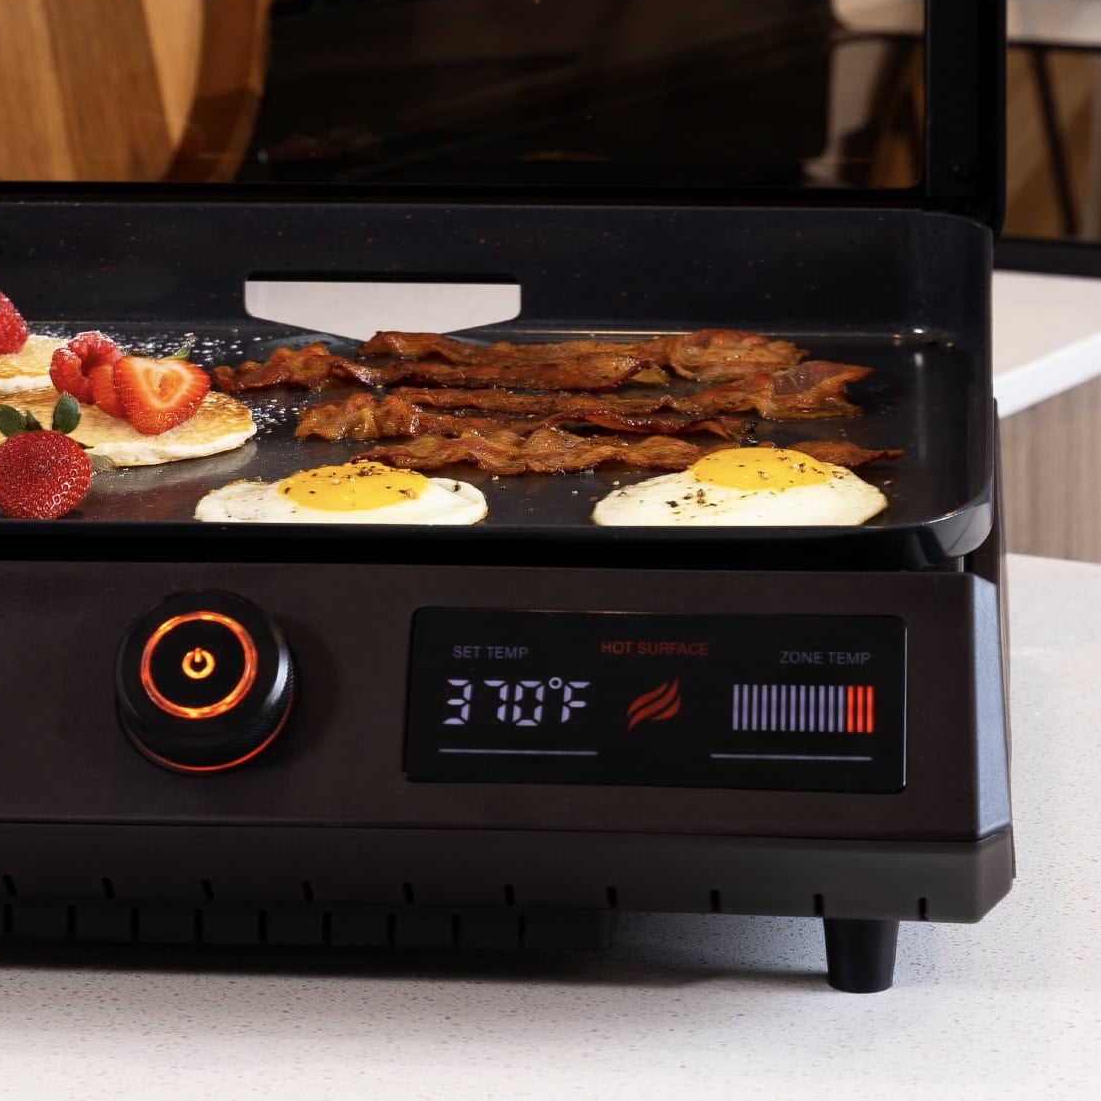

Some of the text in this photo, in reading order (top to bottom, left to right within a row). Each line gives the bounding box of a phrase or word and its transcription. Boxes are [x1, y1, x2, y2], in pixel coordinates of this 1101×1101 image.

[453, 645, 529, 660] SET TEMP
[601, 641, 709, 656] HOT SURFACE
[779, 650, 871, 666] ZONE TEMP
